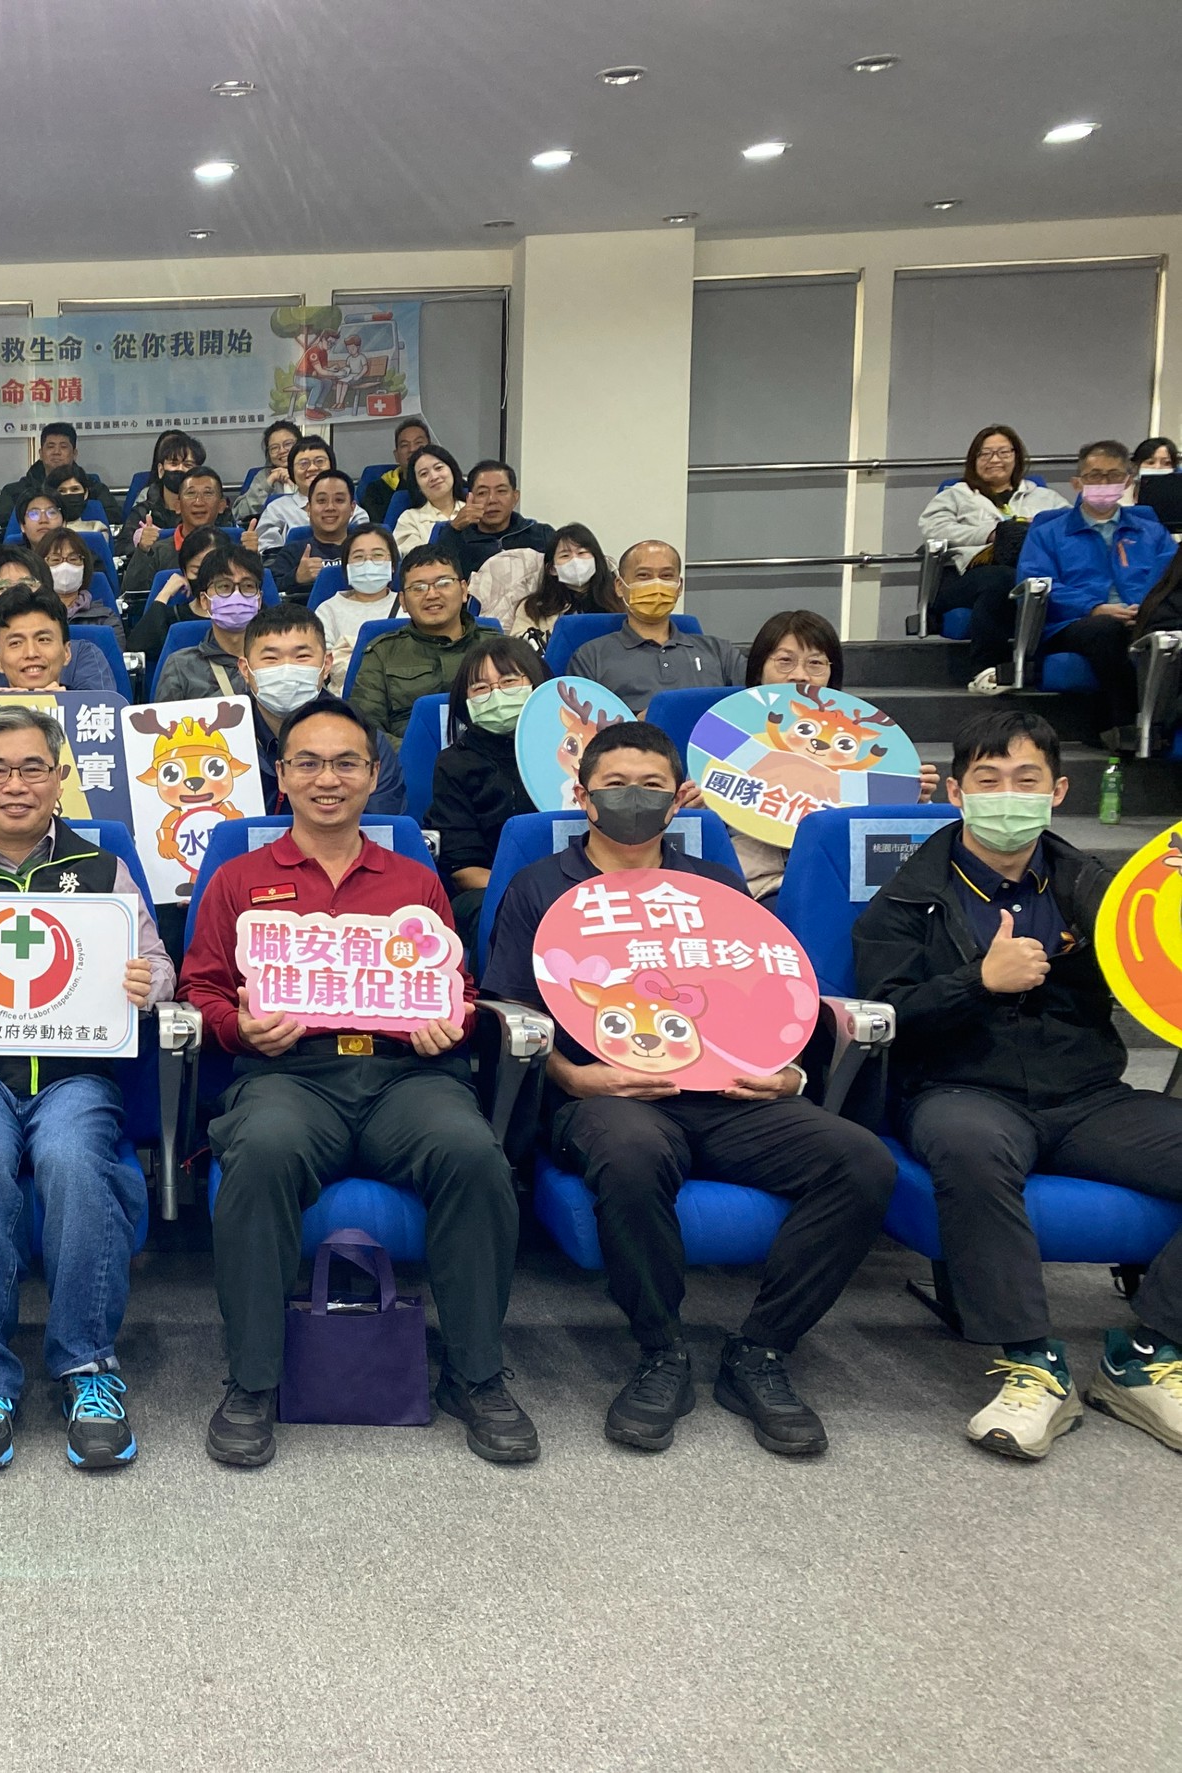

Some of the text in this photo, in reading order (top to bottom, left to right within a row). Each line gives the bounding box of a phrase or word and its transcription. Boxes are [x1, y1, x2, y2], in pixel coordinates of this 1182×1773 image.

[705, 770, 836, 826] 團隊合作
[179, 829, 215, 856] 水
[58, 872, 81, 893] 勞
[572, 881, 705, 936] 生命
[18, 1012, 27, 1021] of
[28, 1007, 51, 1020] Labor
[75, 937, 85, 972] Taoyuan
[626, 937, 802, 978] 無價珍惜
[259, 963, 443, 1011] 健康促進
